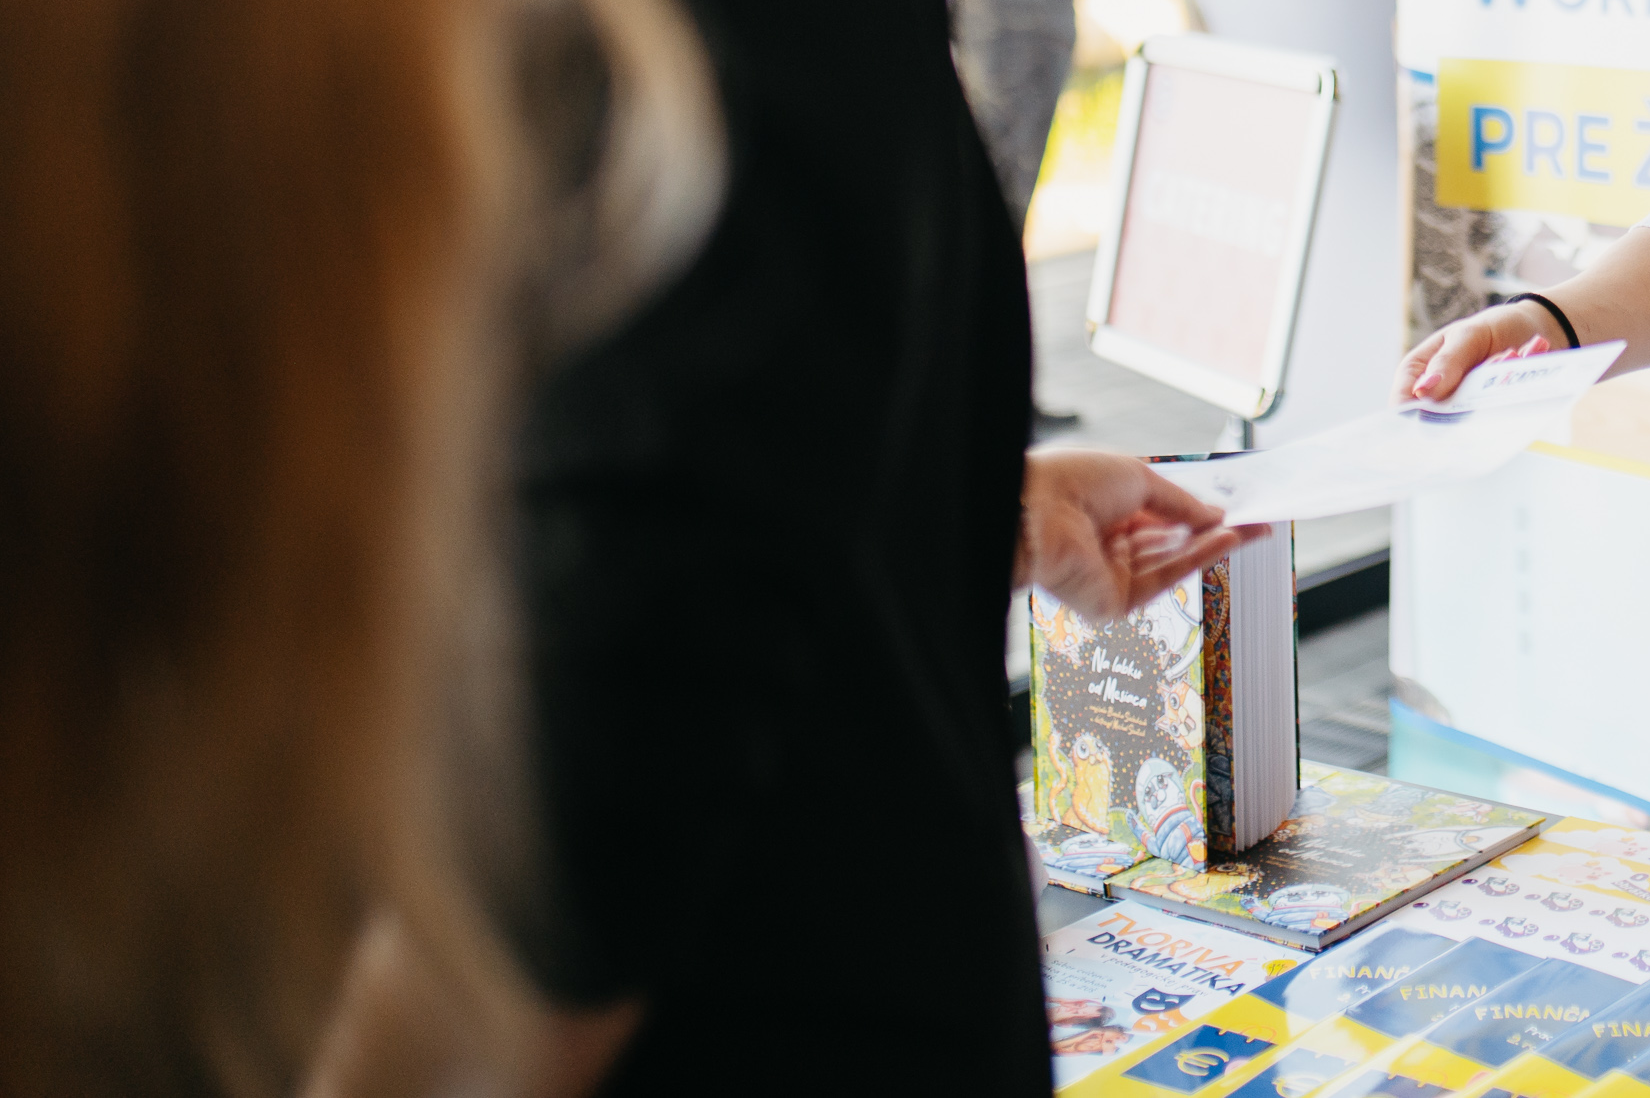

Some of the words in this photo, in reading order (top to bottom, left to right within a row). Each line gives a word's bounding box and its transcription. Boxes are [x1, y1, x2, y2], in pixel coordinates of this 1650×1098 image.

[1468, 105, 1611, 182] PRE
[1091, 645, 1110, 673] Na
[1088, 679, 1105, 696] od
[1630, 873, 1650, 882] O
[1086, 931, 1246, 997] DRAMATIKA
